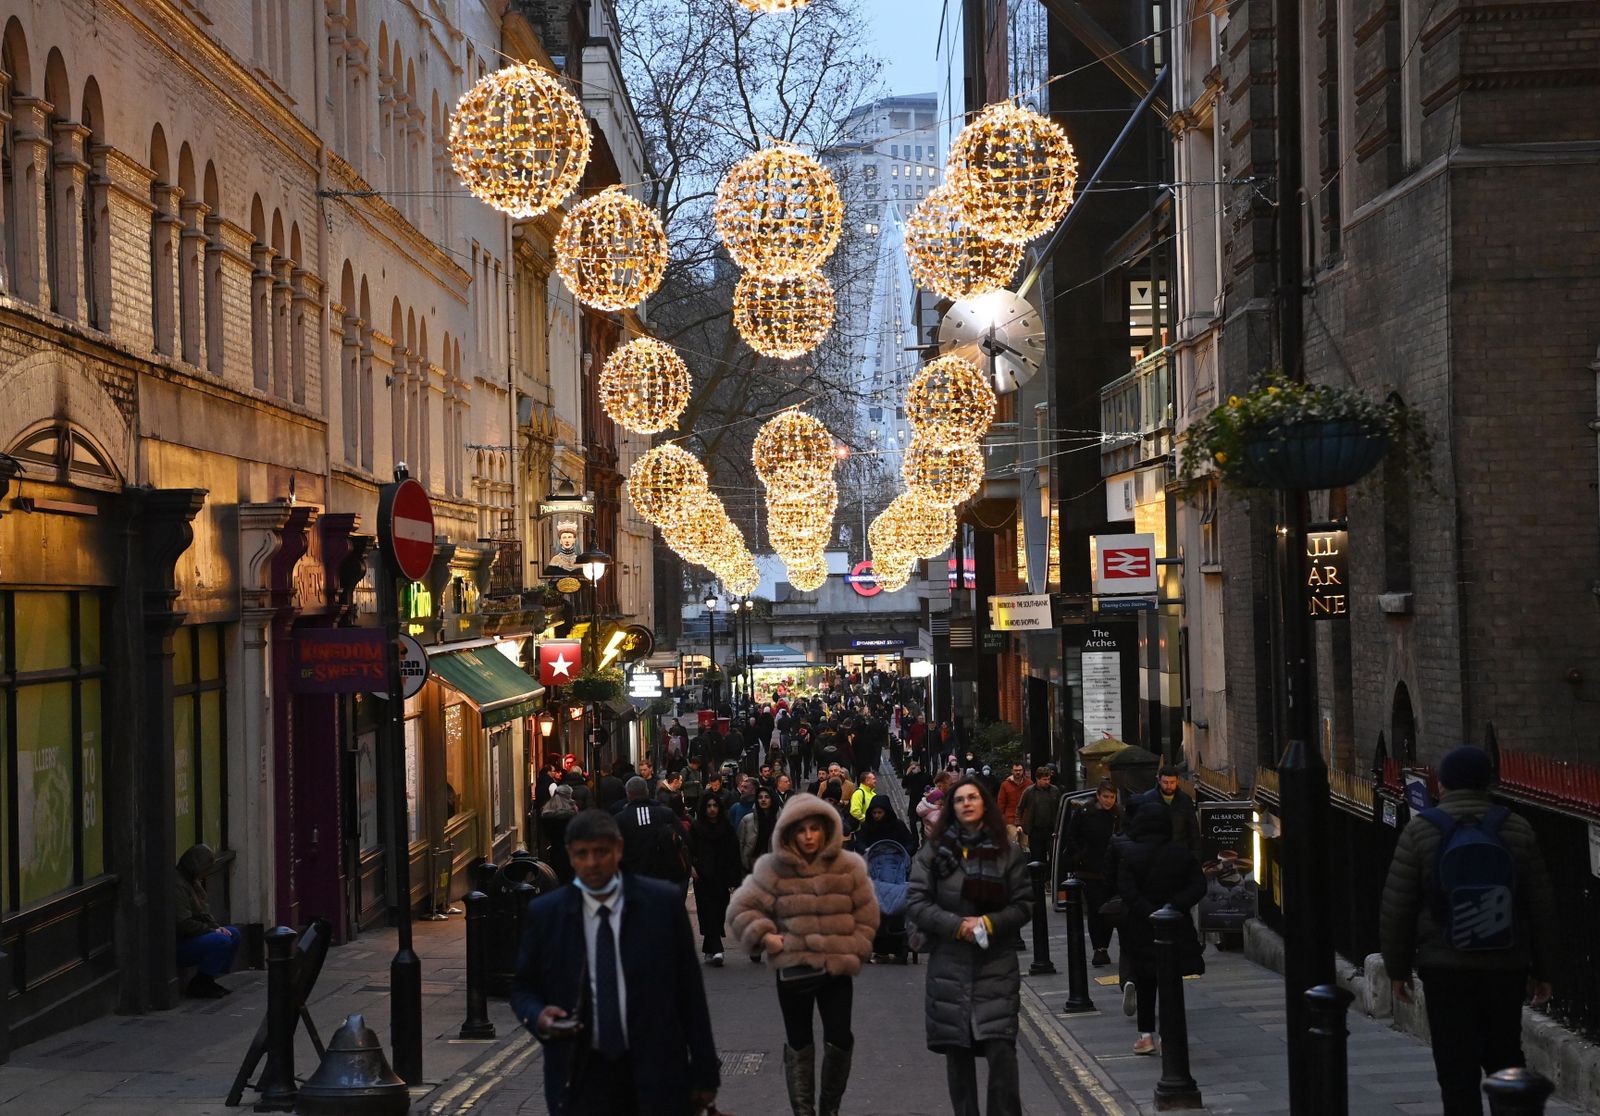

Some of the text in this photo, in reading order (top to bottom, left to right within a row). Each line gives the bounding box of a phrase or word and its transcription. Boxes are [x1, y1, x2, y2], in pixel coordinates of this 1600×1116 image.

[575, 504, 594, 514] WALES
[1307, 537, 1338, 556] LL
[1308, 566, 1341, 586] AR
[1309, 595, 1346, 615] NE
[1085, 639, 1117, 647] Arches
[1092, 629, 1109, 637] The
[301, 640, 383, 661] KINGDOM
[314, 662, 384, 682] SWEETS
[400, 660, 420, 668] an
[82, 746, 96, 785] TO
[83, 790, 97, 829] GO
